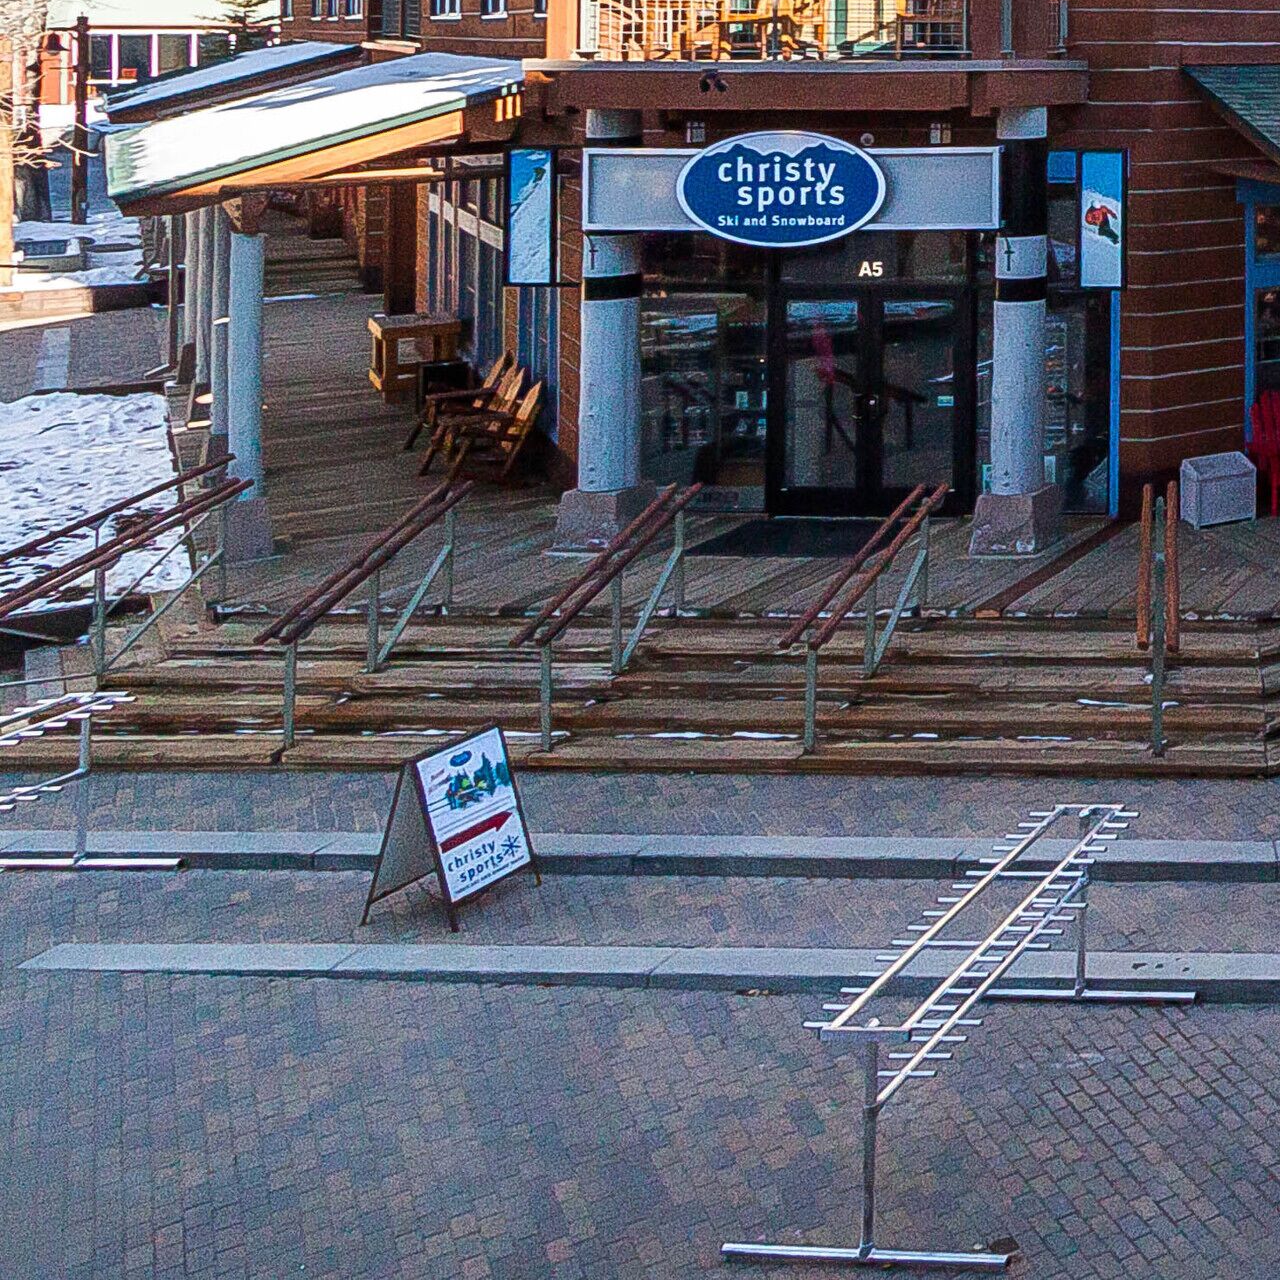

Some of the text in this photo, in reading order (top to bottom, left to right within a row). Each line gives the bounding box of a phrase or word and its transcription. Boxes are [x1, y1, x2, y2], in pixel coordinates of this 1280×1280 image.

[718, 156, 836, 191] christy
[737, 182, 845, 212] sports
[718, 215, 845, 227] Ski and Snowboard
[858, 261, 883, 277] A5
[448, 841, 495, 872] christy
[460, 853, 504, 883] sports
